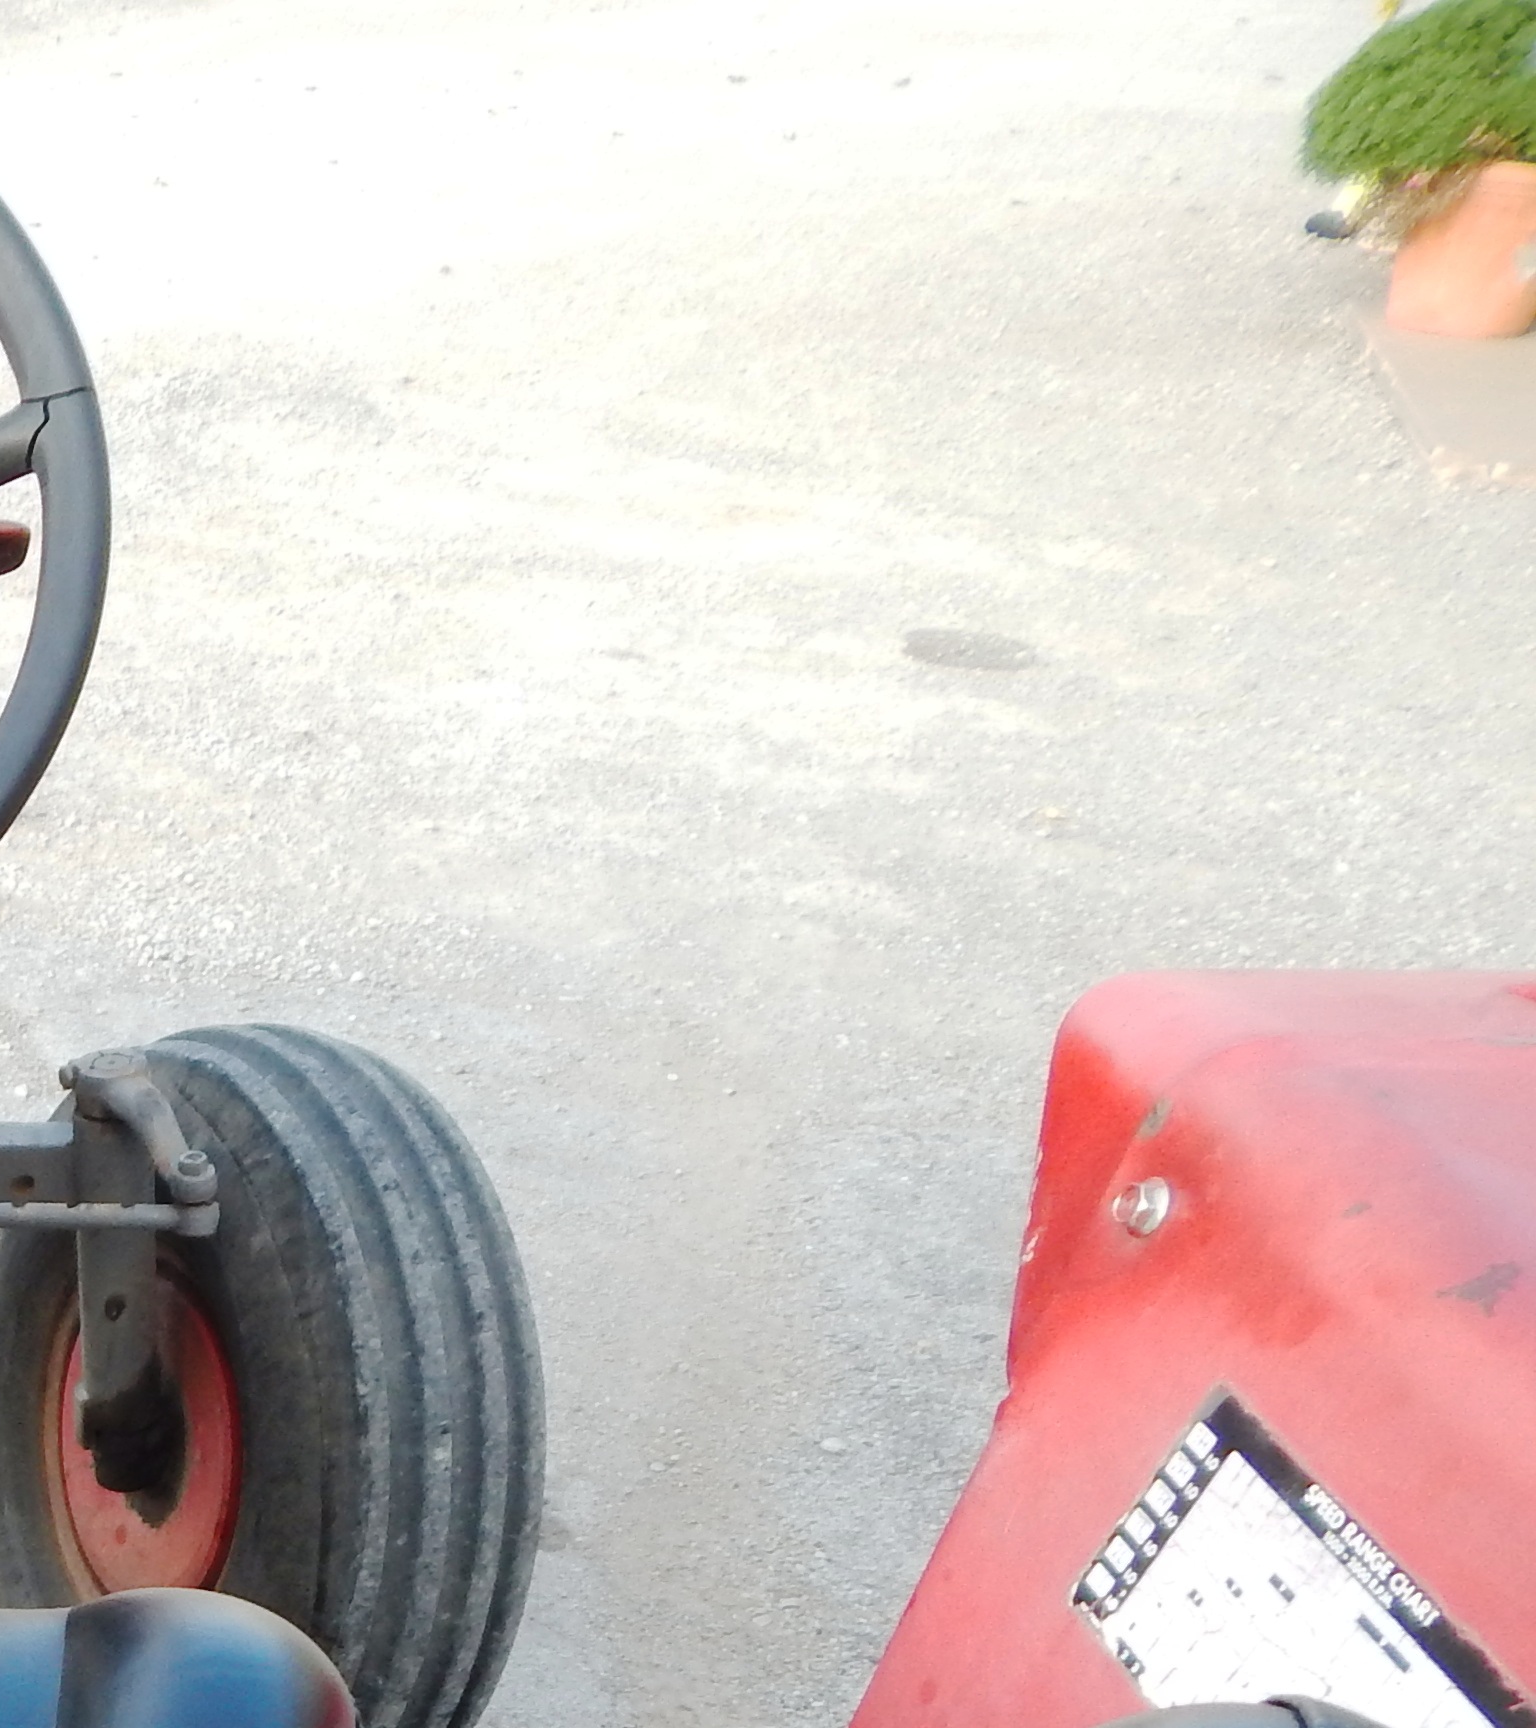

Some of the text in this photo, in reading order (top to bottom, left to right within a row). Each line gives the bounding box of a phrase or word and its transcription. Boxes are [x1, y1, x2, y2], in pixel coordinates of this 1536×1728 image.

[1302, 1484, 1441, 1628] SPEED RANGE CHART
